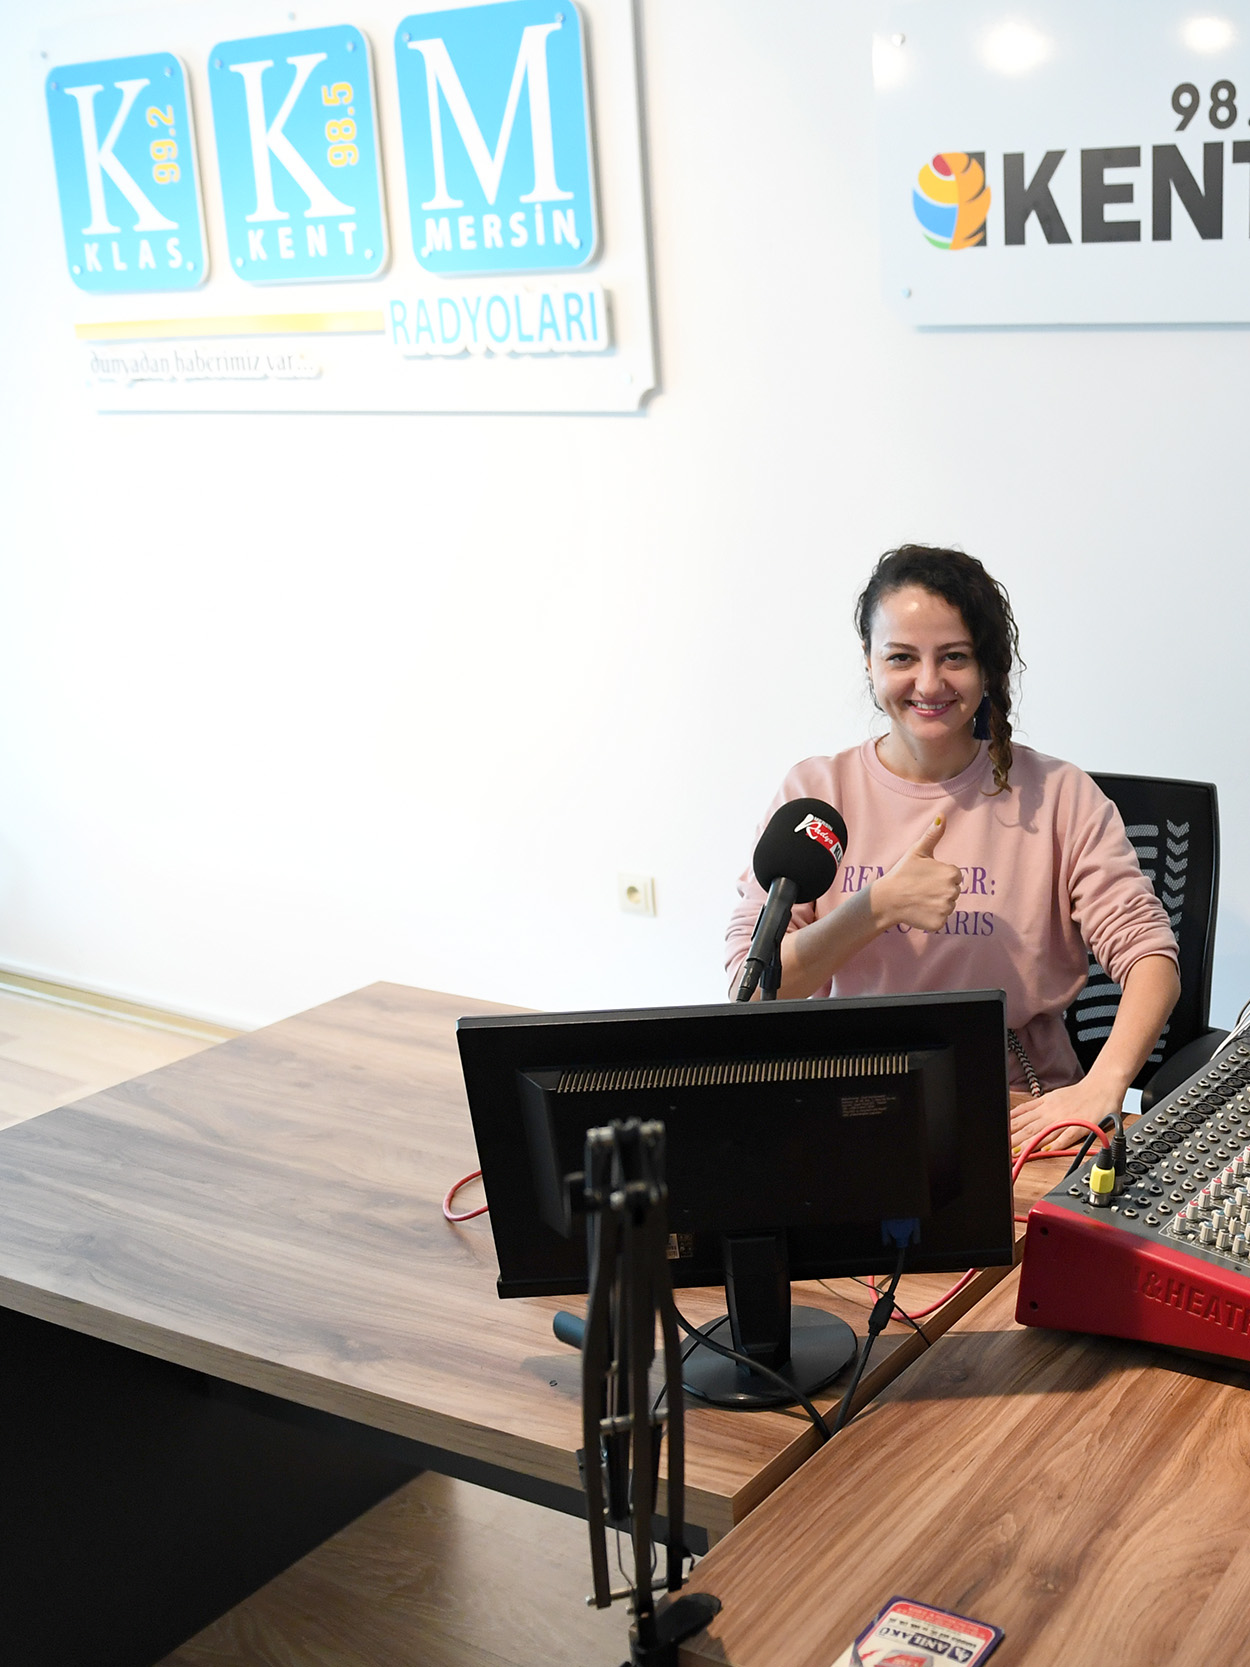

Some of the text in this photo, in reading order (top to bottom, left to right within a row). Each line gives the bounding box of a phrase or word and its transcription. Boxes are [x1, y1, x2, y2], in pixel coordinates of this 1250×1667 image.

[146, 105, 181, 184] 99.2
[228, 52, 356, 223] K
[320, 82, 359, 167] 98.5
[407, 21, 575, 210] M
[64, 78, 179, 236] K
[84, 237, 183, 272] KLAS
[247, 223, 358, 261] KENT
[389, 291, 599, 345] RADYOLARI
[924, 911, 994, 936] ARIS
